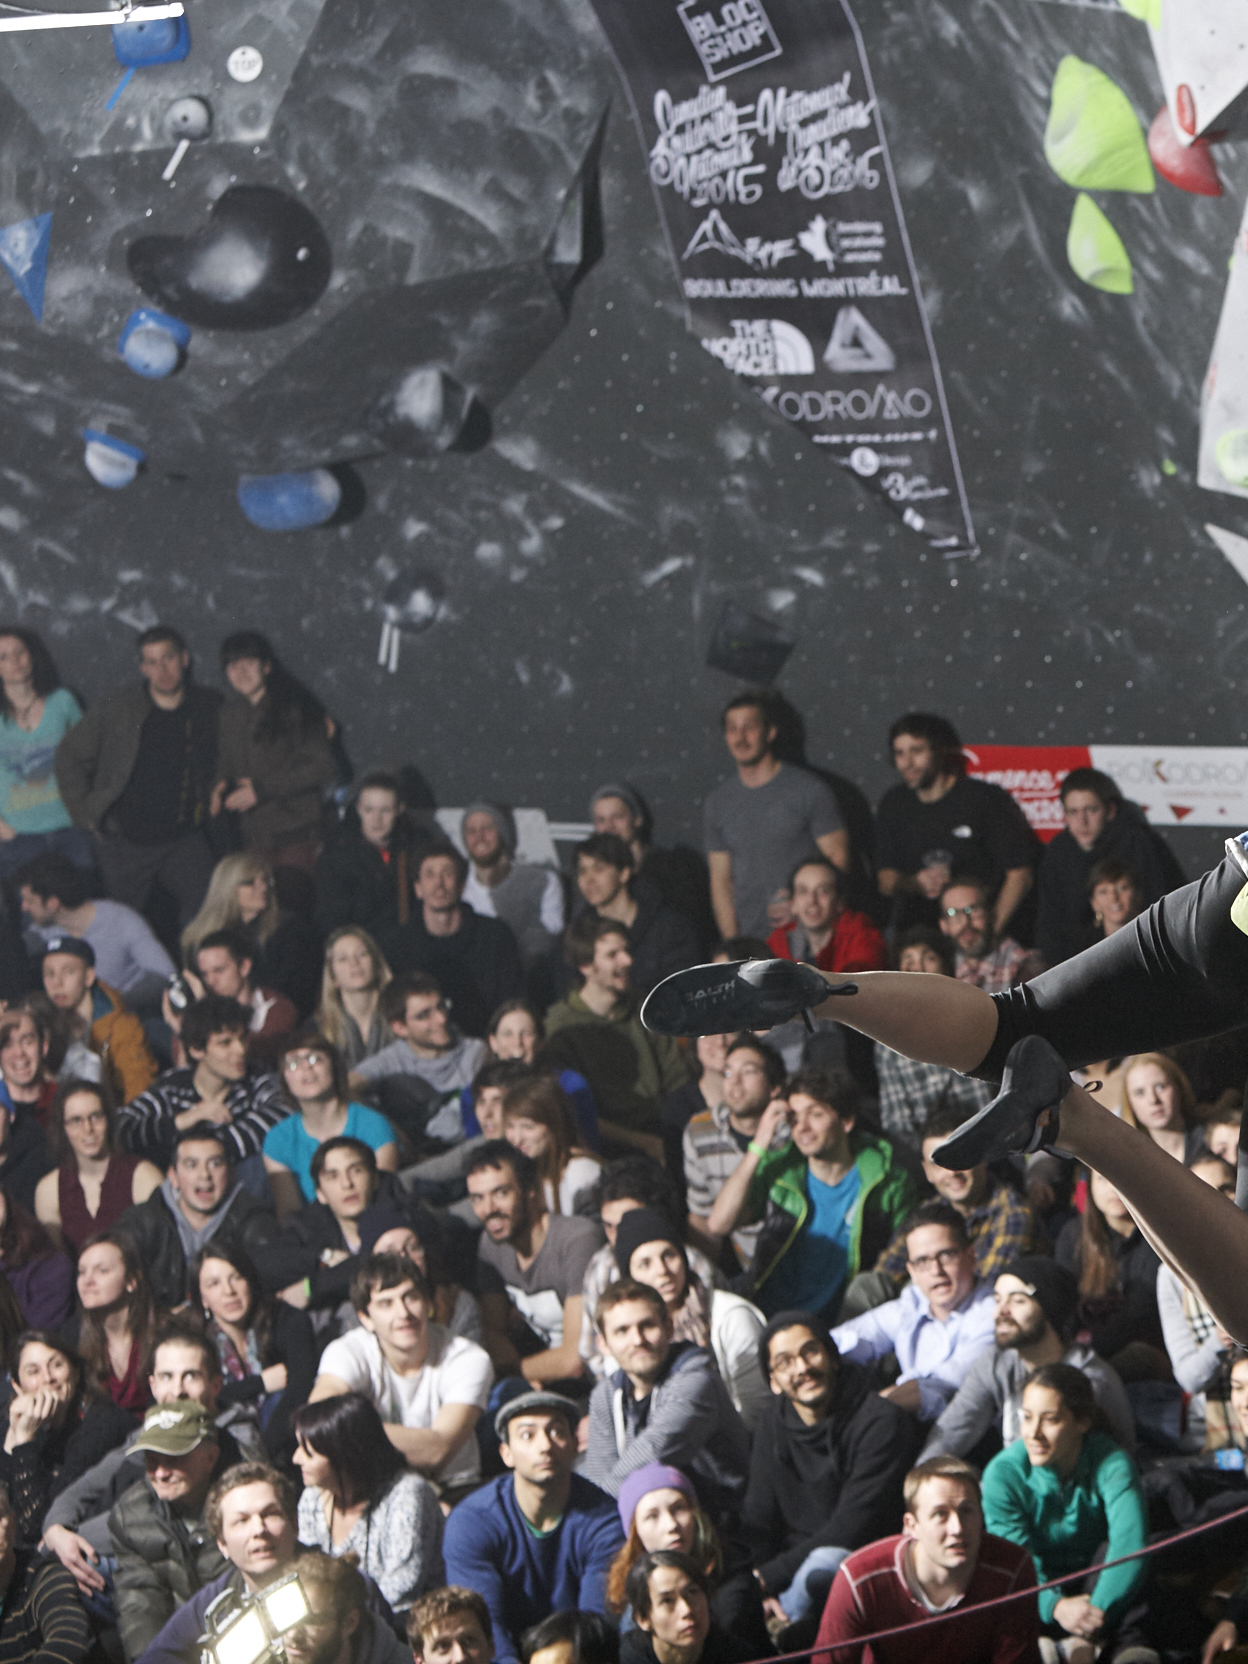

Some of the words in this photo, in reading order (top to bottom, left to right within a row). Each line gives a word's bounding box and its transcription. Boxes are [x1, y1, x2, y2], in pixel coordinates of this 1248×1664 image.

[690, 0, 760, 42] BLOC
[700, 20, 767, 64] SHOP
[690, 163, 766, 207] 2015
[683, 278, 799, 299] BOULDERING
[801, 269, 909, 298] MONTRÉAL
[729, 319, 769, 339] THE
